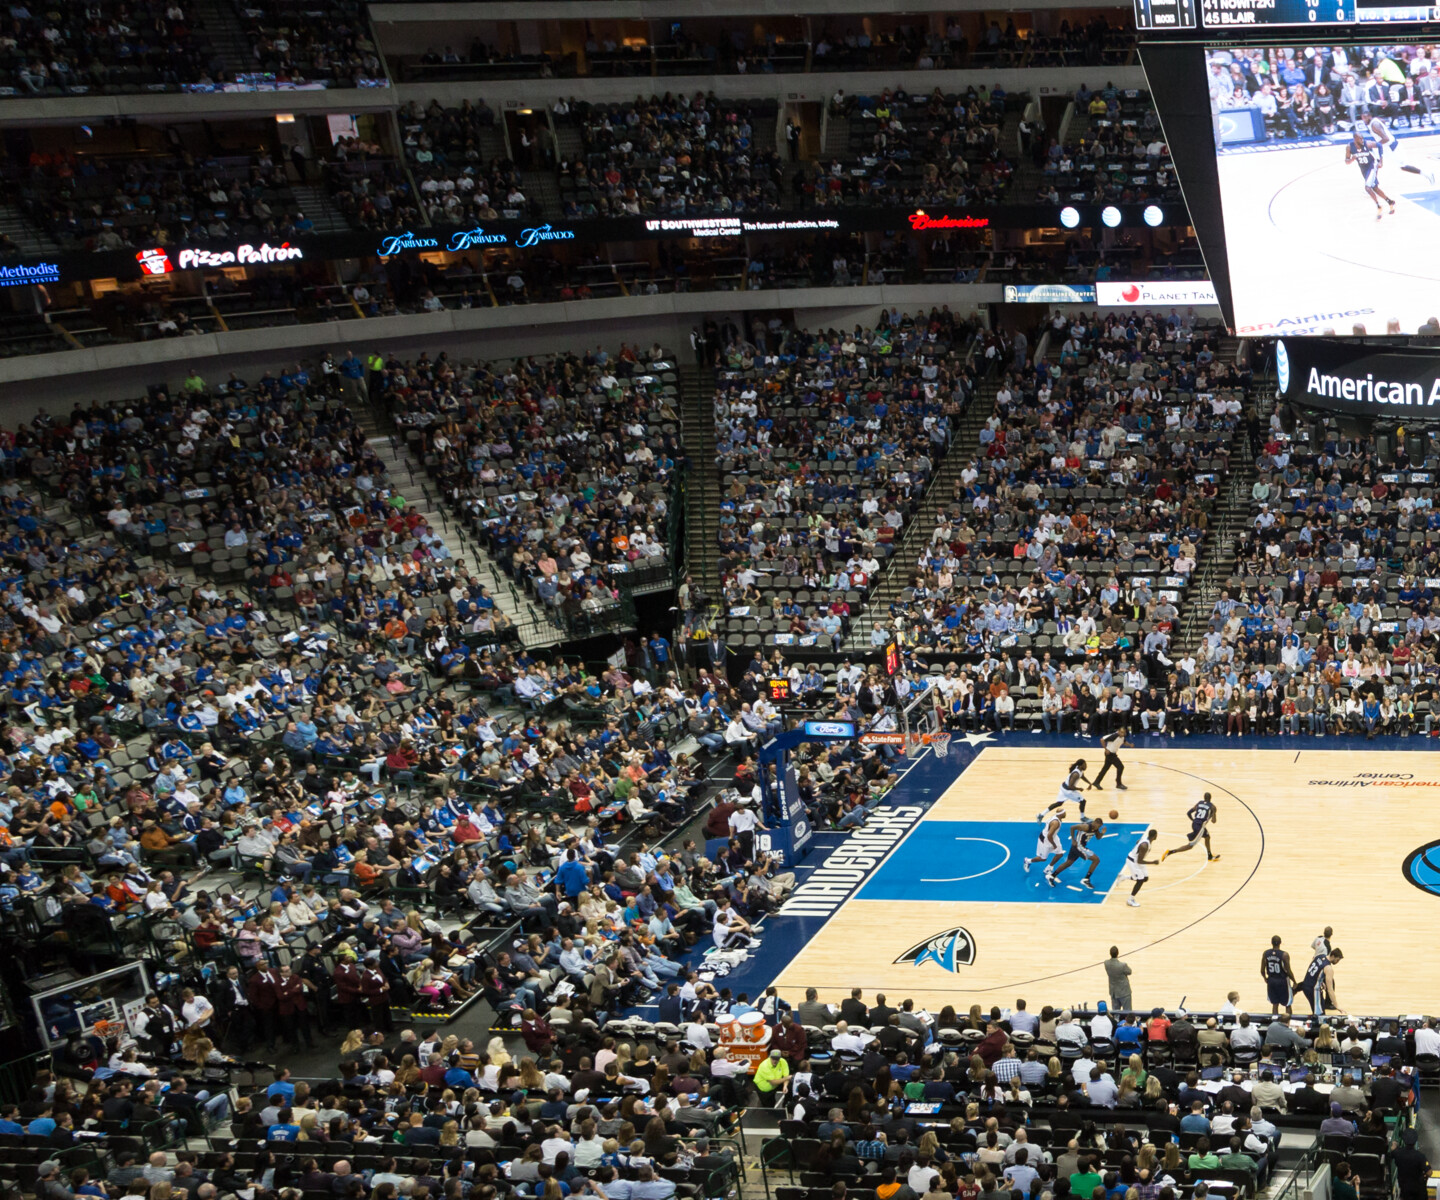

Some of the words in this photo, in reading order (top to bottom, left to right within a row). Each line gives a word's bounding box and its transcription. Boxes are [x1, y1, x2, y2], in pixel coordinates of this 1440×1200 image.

[1221, 0, 1275, 9] NOWITZKI
[1184, 13, 1189, 25] 1
[1205, 12, 1220, 24] 45
[1221, 12, 1255, 24] BLAIR
[1308, 10, 1316, 21] 0
[1336, 9, 1344, 20] 0
[1433, 7, 1440, 20] 0
[1141, 14, 1146, 26] 1
[646, 221, 660, 231] UT
[661, 218, 741, 230] SOUTHWESTERN
[743, 222, 757, 230] The
[757, 221, 778, 230] future
[778, 221, 785, 229] of
[908, 214, 989, 230] Budweiser
[693, 228, 719, 237] Medical
[720, 227, 742, 236] Center
[179, 249, 235, 269] Pizza
[237, 242, 303, 264] Patrón
[1143, 292, 1188, 301] PLANET
[1192, 291, 1214, 300] TAN
[1308, 367, 1424, 405] American
[772, 688, 786, 700] 21
[819, 726, 839, 734] Ford
[779, 805, 924, 917] MAVERICKS
[1268, 962, 1281, 974] 50
[691, 1000, 700, 1013] 7
[714, 1001, 729, 1014] 22
